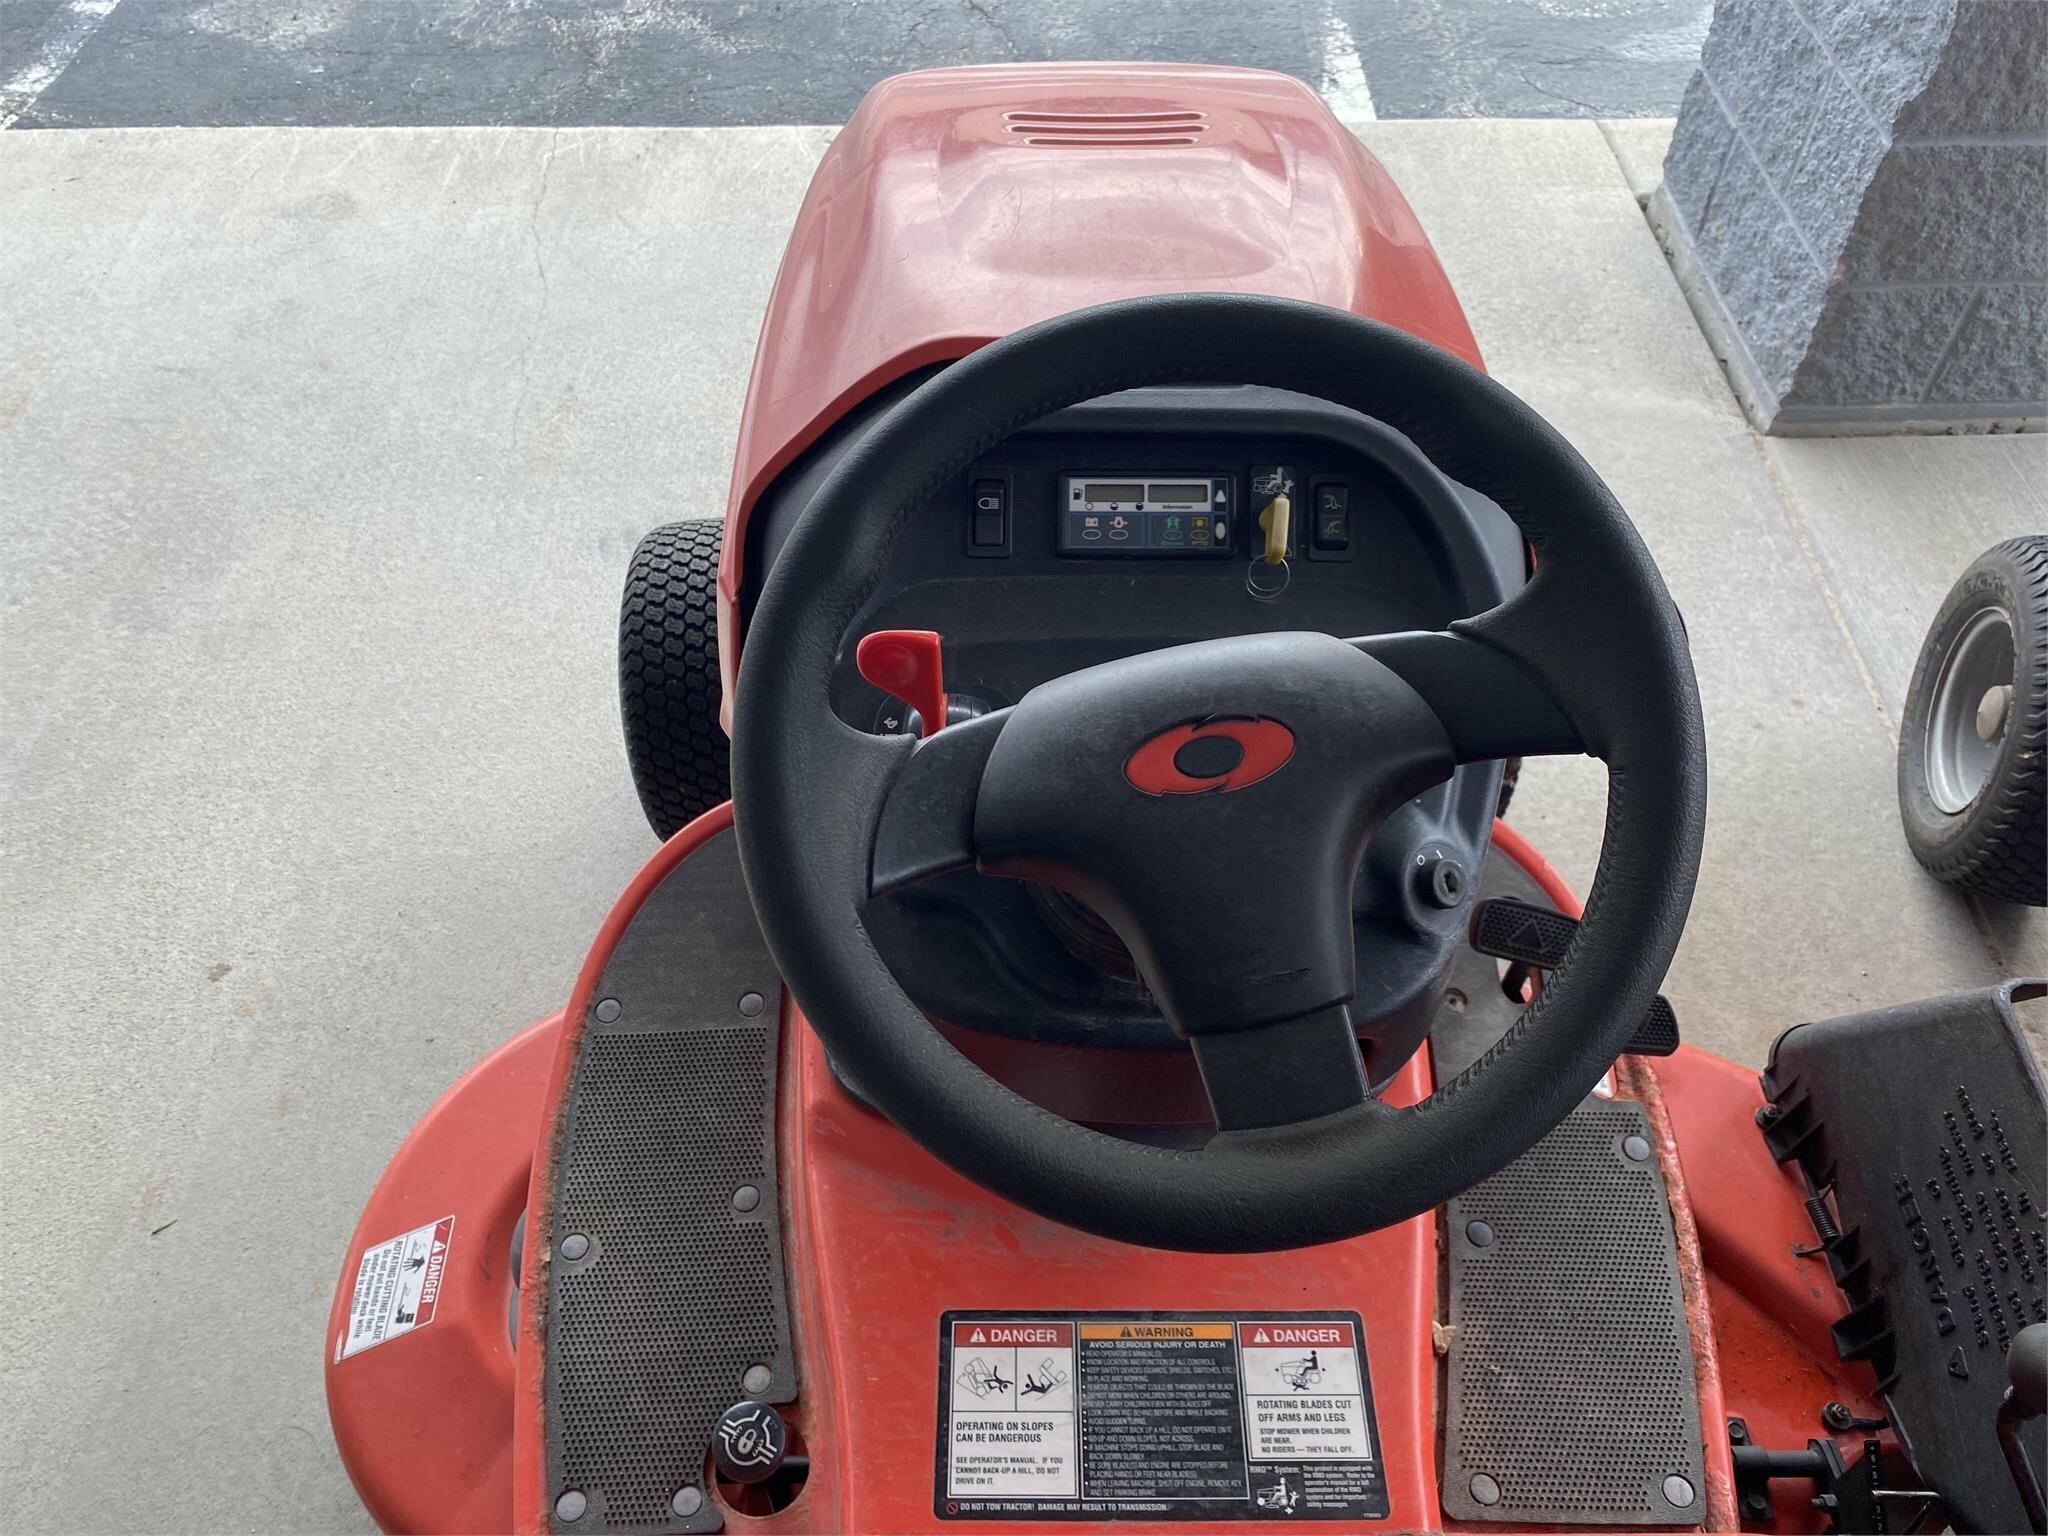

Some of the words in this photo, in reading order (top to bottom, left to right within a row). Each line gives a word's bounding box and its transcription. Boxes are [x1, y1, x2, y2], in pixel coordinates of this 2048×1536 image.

[1943, 1111, 1975, 1177] mower
[1981, 1152, 1996, 1176] or
[1926, 1178, 1942, 1200] of
[1976, 1191, 2009, 1273] operate
[1942, 1216, 1965, 1268] clear
[382, 1249, 392, 1258] Do
[387, 1240, 403, 1278] ROTATING
[1895, 1174, 1956, 1337] DANGER
[379, 1260, 388, 1272] not
[364, 1275, 374, 1298] mower
[376, 1273, 385, 1284] put
[421, 1255, 443, 1304] DANGER
[371, 1285, 382, 1307] hands
[379, 1280, 394, 1314] CUTTING
[368, 1308, 376, 1316] or
[1963, 1284, 1990, 1349] Stand
[354, 1319, 364, 1338] while
[372, 1316, 386, 1341] BLADE
[991, 1330, 1057, 1342] DANGER
[1134, 1328, 1193, 1337] WARNING
[1274, 1330, 1340, 1342] DANGER
[1090, 1341, 1114, 1349] AVOID
[1115, 1341, 1152, 1349] SERIOUS
[1153, 1341, 1182, 1349] INJURY
[1184, 1341, 1197, 1349] OR
[1198, 1341, 1226, 1349] DEATH
[1257, 1400, 1298, 1409] ROTATING
[1300, 1400, 1333, 1409] BLADES
[1335, 1400, 1351, 1409] CUT
[957, 1422, 1004, 1430] OPERATING
[1006, 1422, 1018, 1430] ON
[1021, 1422, 1054, 1430] SLOPES
[1258, 1413, 1274, 1422] OFF
[1276, 1413, 1301, 1422] ARMS
[1304, 1413, 1322, 1422] AND
[1324, 1413, 1346, 1422] LEGS
[956, 1434, 976, 1442] CAN
[976, 1434, 986, 1442] BE
[989, 1434, 1042, 1442] DANGEROUS
[960, 1503, 970, 1511] DO
[971, 1503, 985, 1511] NOT
[987, 1503, 1001, 1511] TOW
[1003, 1503, 1034, 1511] TRACTOR!
[1038, 1503, 1065, 1511] DAMAGE
[1067, 1503, 1080, 1511] MAY
[1082, 1503, 1106, 1511] RESULT
[1108, 1503, 1116, 1511] TO
[1118, 1503, 1168, 1511] TRANSMISSION.
